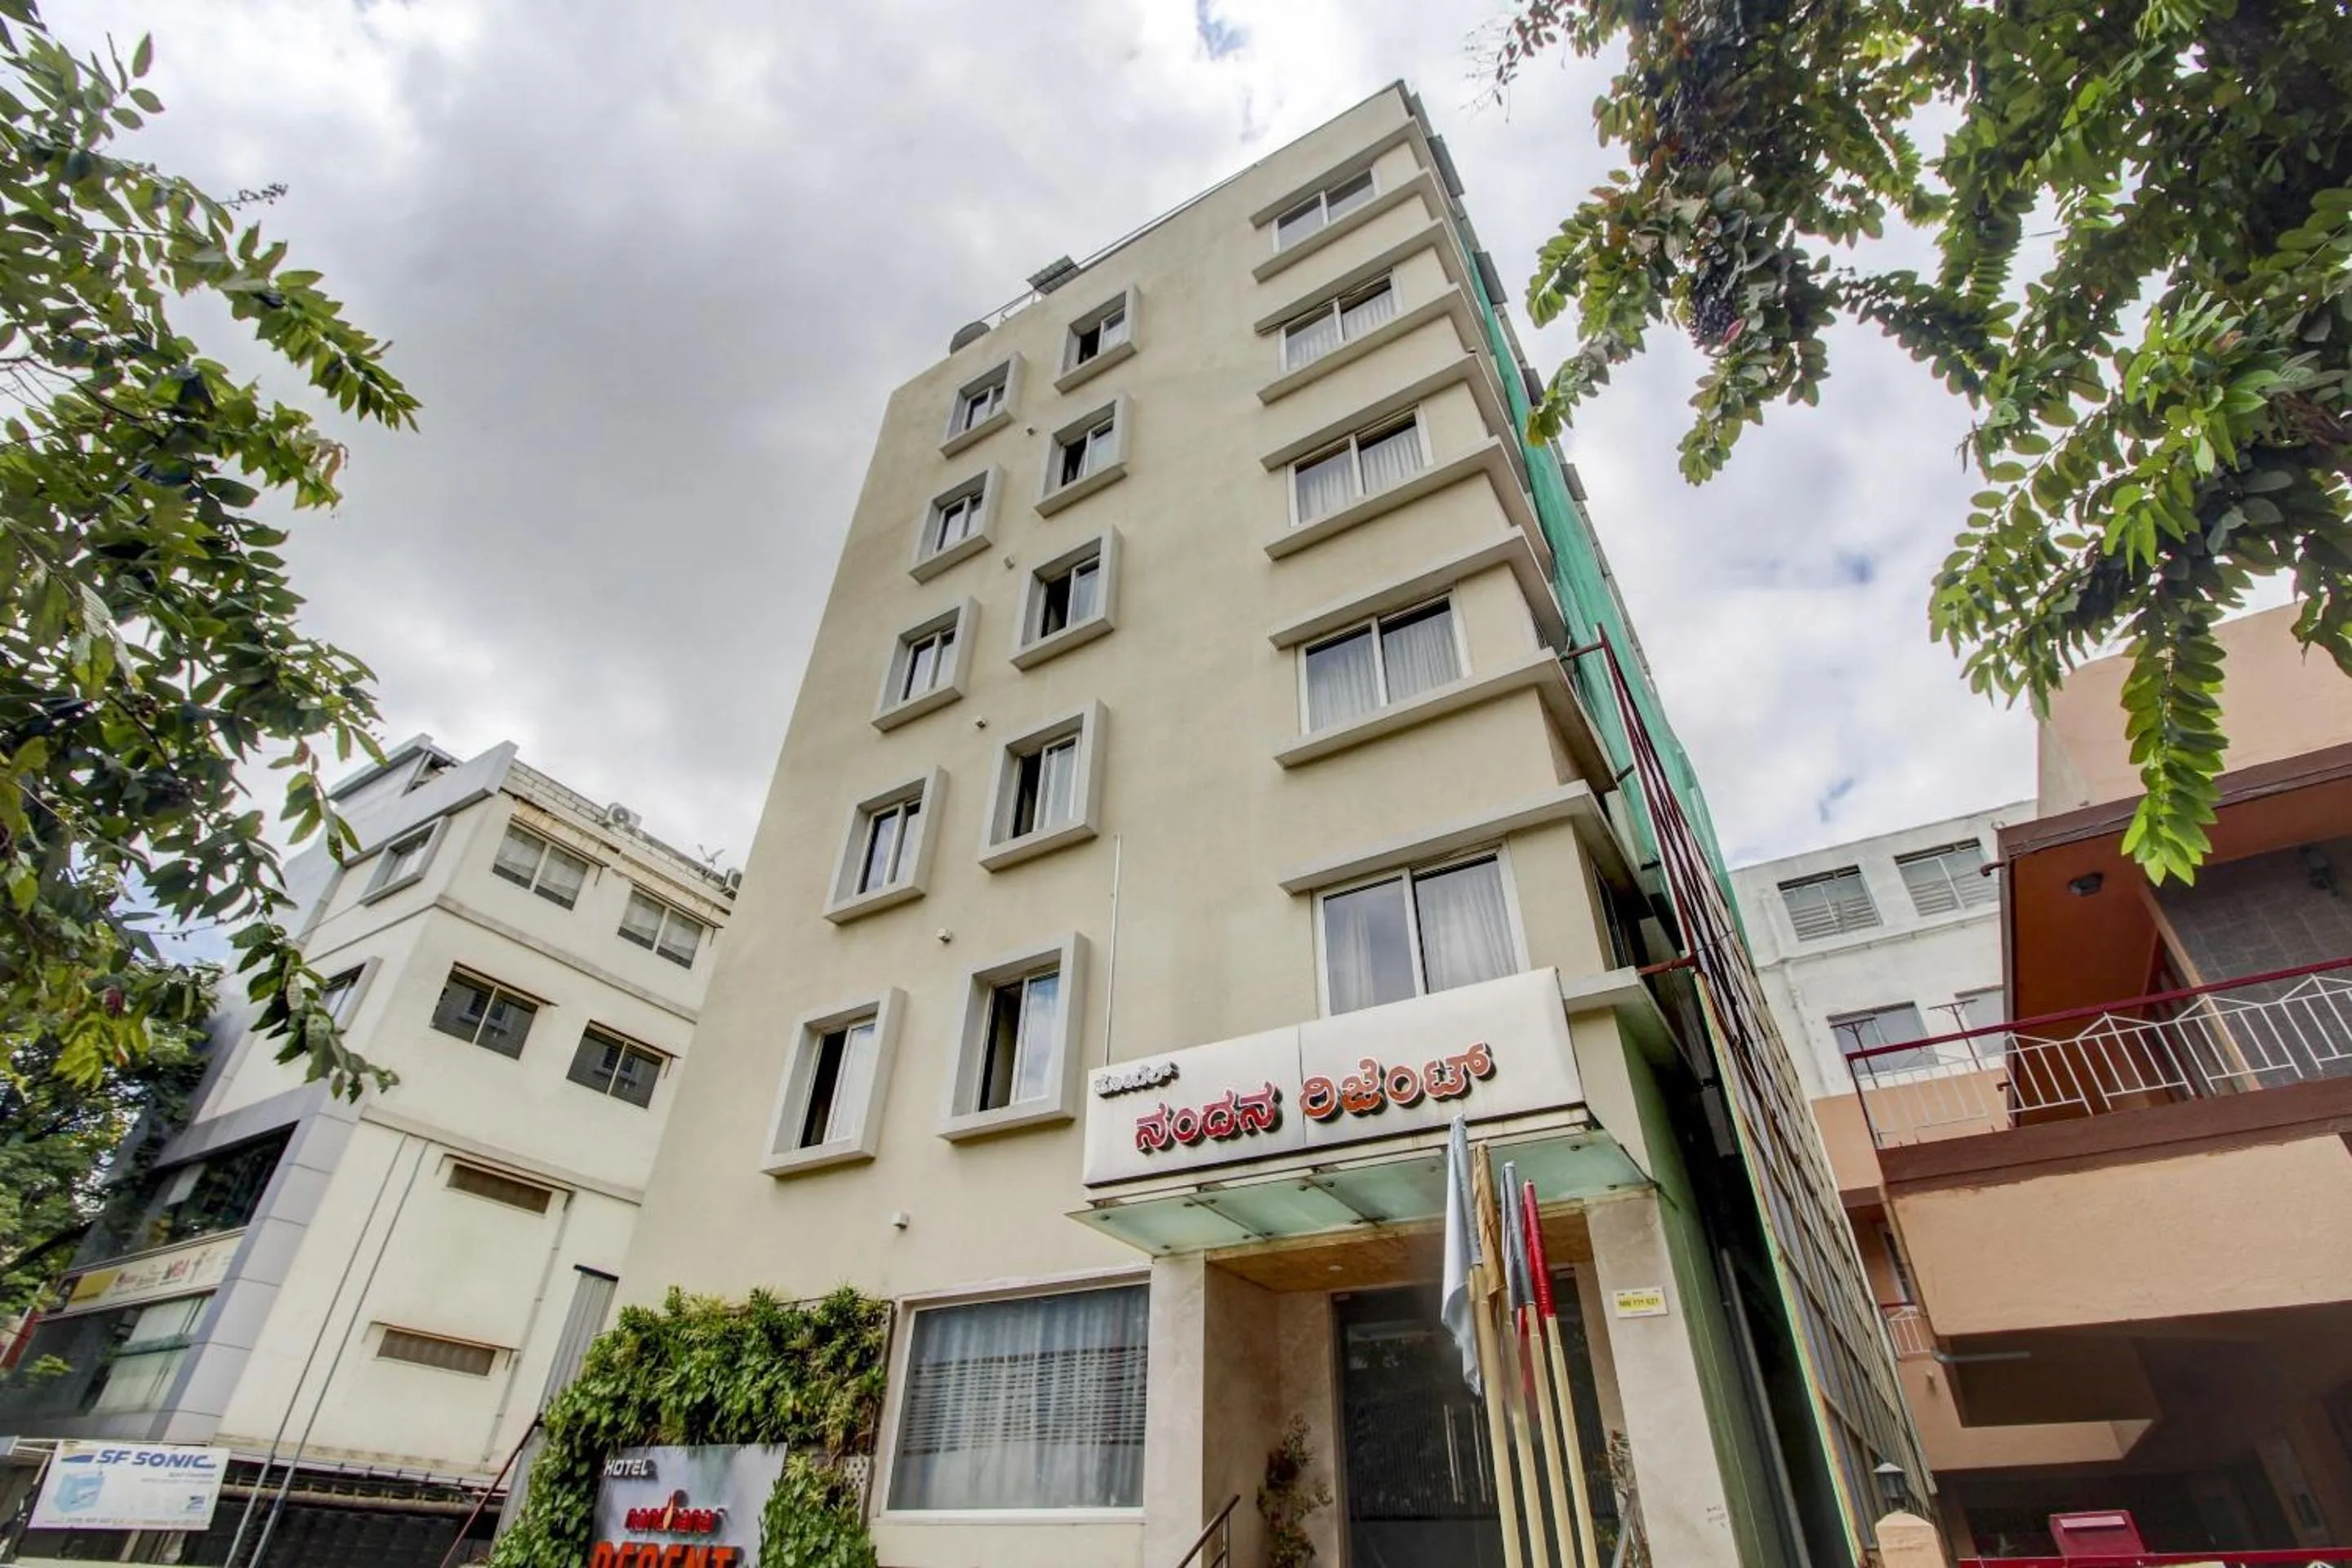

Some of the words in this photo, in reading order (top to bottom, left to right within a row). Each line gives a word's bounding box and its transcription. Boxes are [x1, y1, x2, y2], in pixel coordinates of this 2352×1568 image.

[1135, 1080, 1276, 1150] ನಂದನ
[96, 1450, 131, 1464] SF
[132, 1452, 216, 1468] SONIC
[603, 1459, 650, 1477] HOTEL
